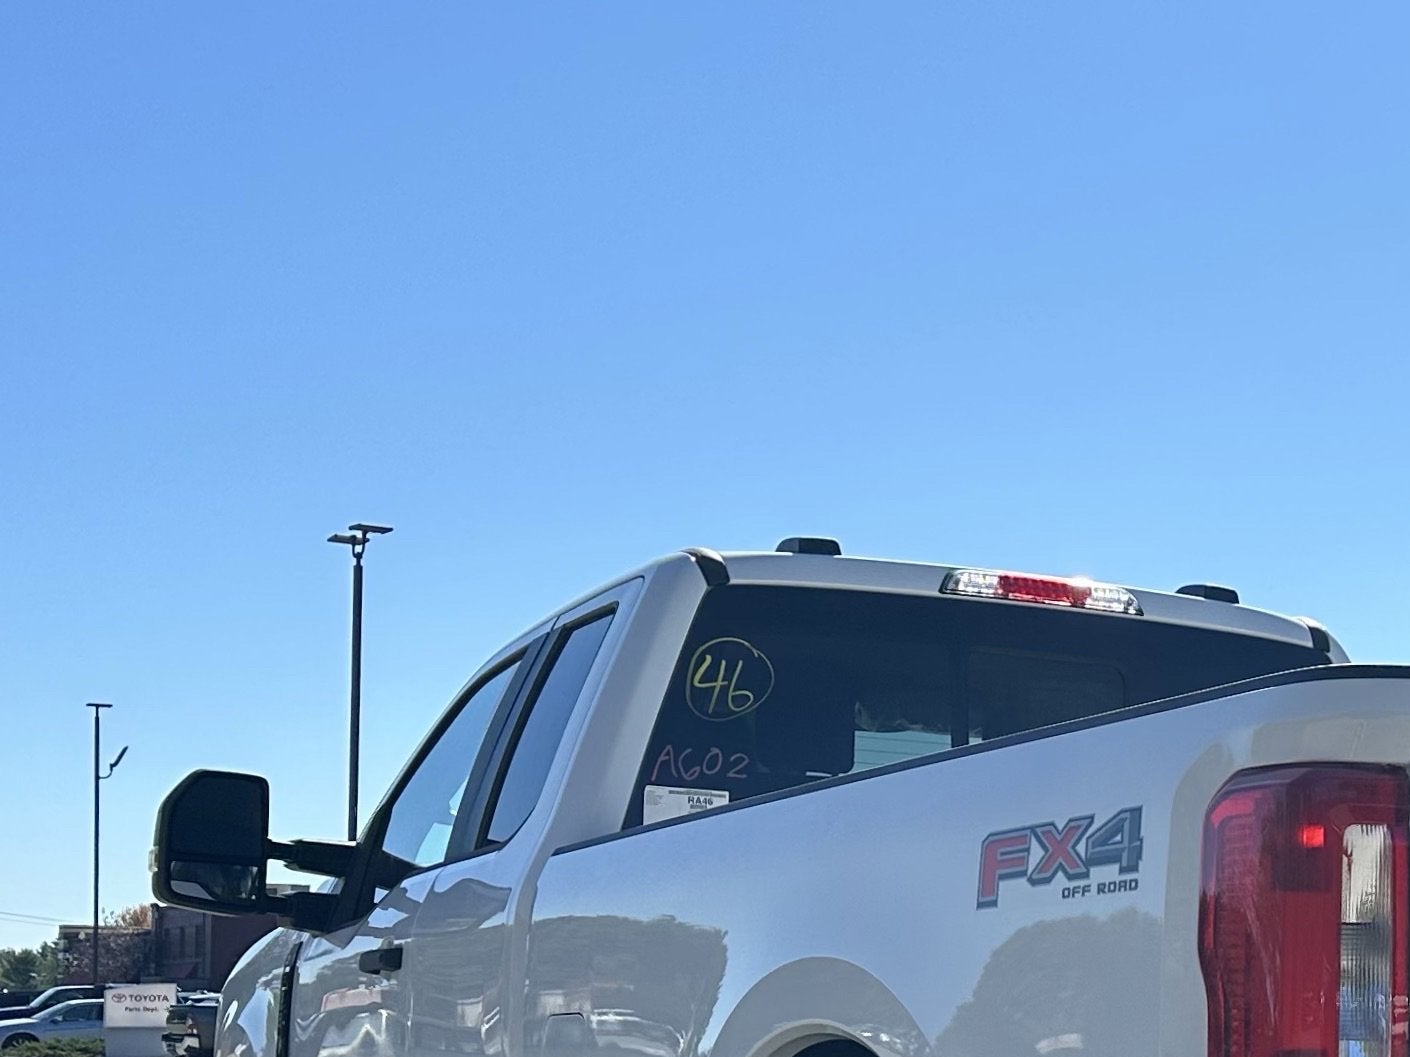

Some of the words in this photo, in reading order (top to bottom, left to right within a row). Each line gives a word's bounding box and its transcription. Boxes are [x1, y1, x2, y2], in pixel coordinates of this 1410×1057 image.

[693, 654, 754, 714] 46
[651, 745, 749, 782] A602
[976, 804, 1144, 911] FX4
[1061, 883, 1092, 899] OFF
[1097, 878, 1139, 896] ROAD
[128, 993, 170, 1003] TOYOTA
